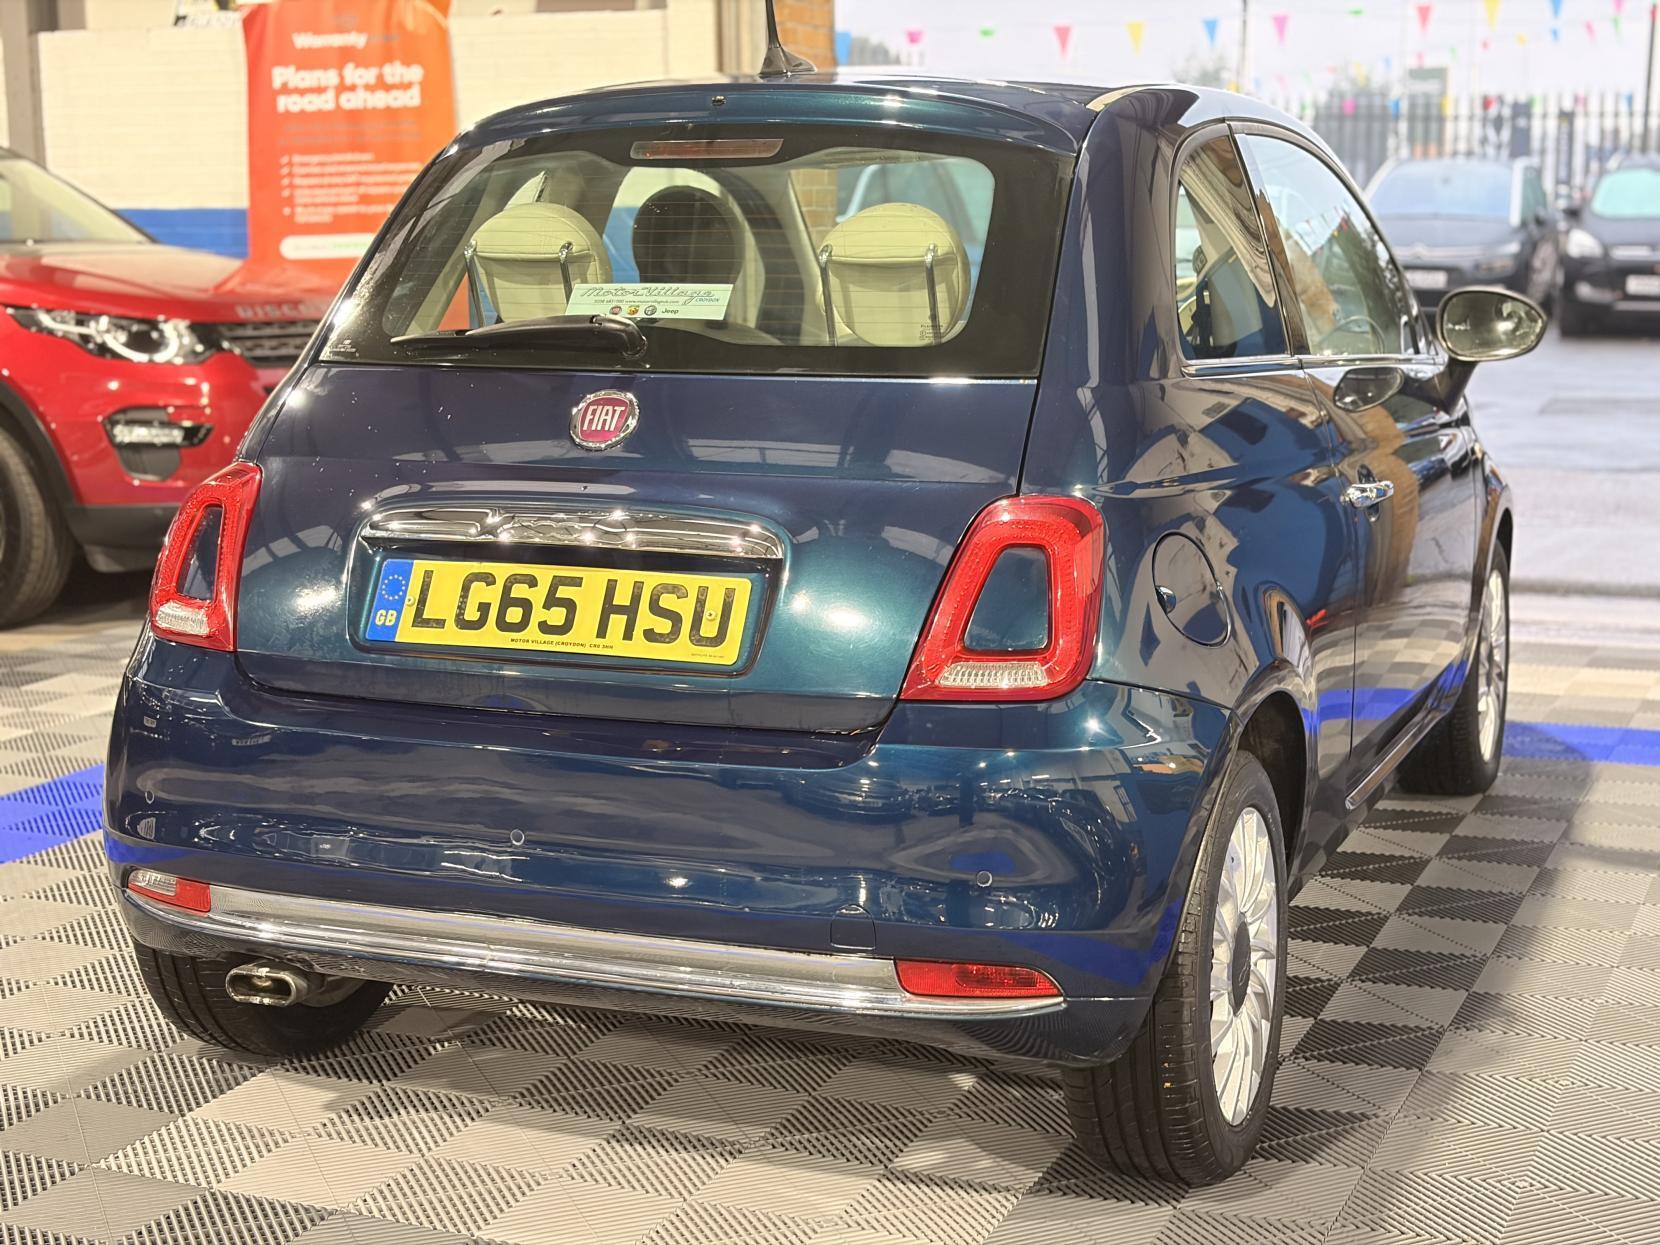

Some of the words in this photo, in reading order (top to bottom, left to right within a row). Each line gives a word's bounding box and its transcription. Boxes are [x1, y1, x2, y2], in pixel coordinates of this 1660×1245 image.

[272, 65, 340, 89] Plans
[342, 62, 379, 86] for
[381, 60, 424, 84] the
[276, 88, 336, 112] road
[339, 83, 421, 109] ahead
[661, 307, 679, 315] Jeep
[583, 405, 625, 431] FIAT
[375, 609, 398, 626] GB
[411, 569, 584, 636] LG65
[596, 578, 736, 648] HSU
